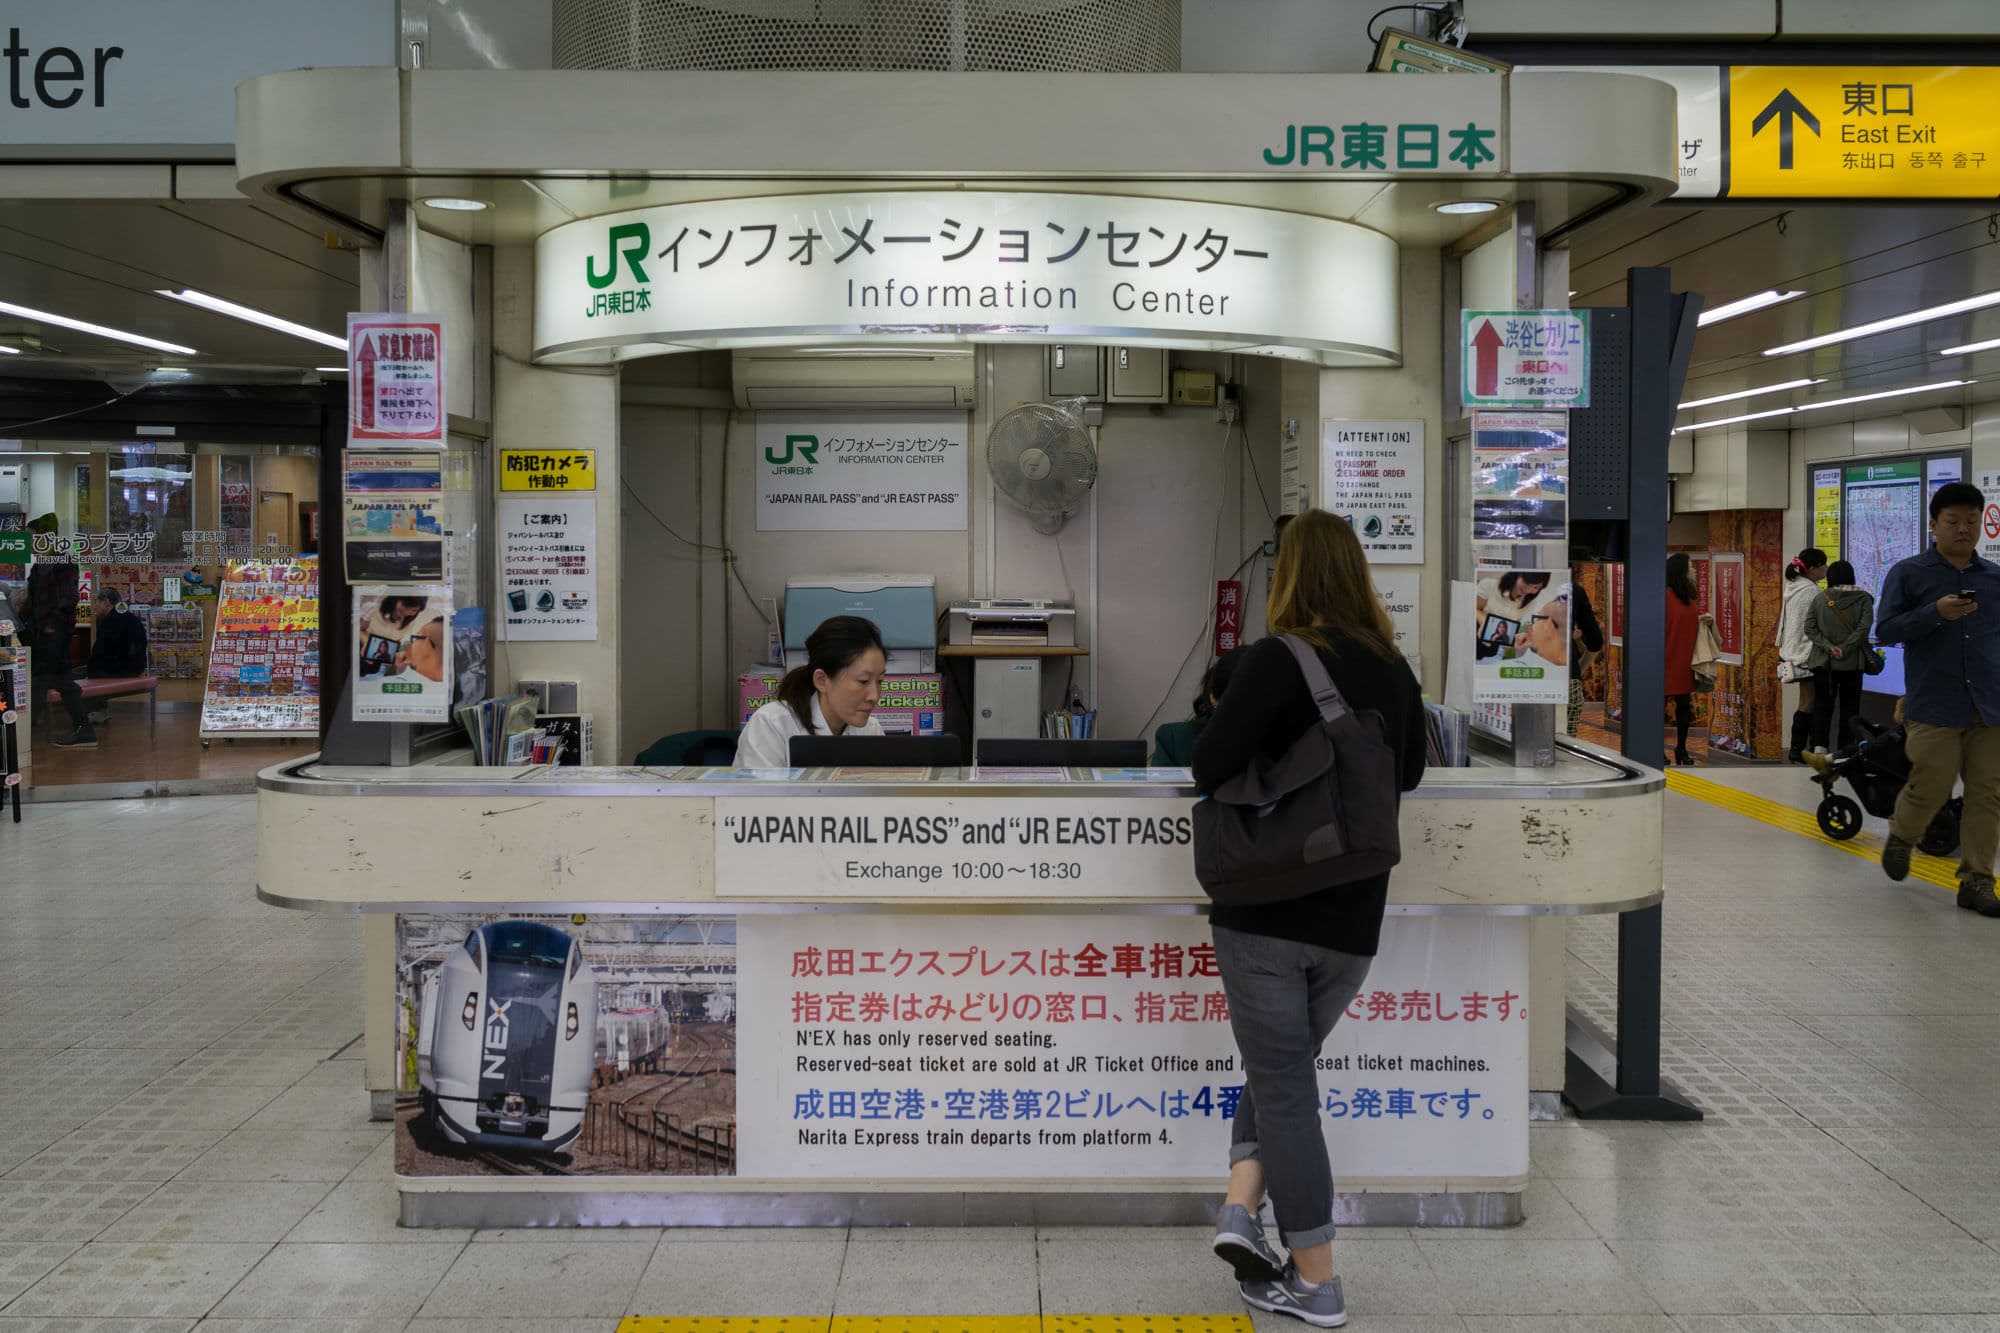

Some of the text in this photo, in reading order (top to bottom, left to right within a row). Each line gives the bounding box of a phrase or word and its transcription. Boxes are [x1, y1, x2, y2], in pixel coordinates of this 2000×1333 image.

[1841, 81, 1914, 117] 東口
[1841, 124, 1937, 144] East Exit
[1263, 122, 1496, 170] JR東日本
[1842, 152, 1895, 169] 东出口
[1908, 152, 1988, 169] 동쪽 출구
[658, 217, 1270, 273] インフォメーションセンター
[586, 222, 651, 290] JR
[586, 287, 652, 318] JR東日本
[848, 278, 1230, 316] Information Center
[1504, 320, 1580, 348] 渋谷ヒカリエ
[765, 434, 820, 465] JR
[823, 436, 960, 453] インフォメーションセンター
[506, 455, 589, 472] 防犯カメラ
[838, 455, 944, 464] INFORMATION CENTER
[771, 466, 814, 476] JR東日本
[1383, 469, 1406, 478] ORDER
[528, 474, 569, 489] 作動中
[805, 493, 828, 504] RAIL
[899, 494, 926, 504] EAST
[33, 531, 154, 554] びゅうプラザ
[35, 554, 153, 563] Travel Service Center
[1220, 588, 1238, 650] 消火器
[821, 815, 878, 845] RAIL
[962, 820, 1005, 845] and
[1056, 816, 1121, 845] EAST
[1126, 816, 1192, 845] PASS
[845, 861, 943, 881] Exchange
[791, 943, 1220, 979] 成田エクスプレスは全車指定
[843, 1031, 872, 1046] has
[878, 1031, 911, 1050] only
[918, 1031, 988, 1046] reserved
[994, 1031, 1057, 1050] seating.
[797, 1057, 915, 1073] Reserved-seat
[920, 1057, 965, 1073] ticket
[972, 1061, 998, 1073] are
[1004, 1057, 1036, 1073] sold
[1043, 1058, 1060, 1073] at
[1066, 1057, 1088, 1073] JR
[1095, 1057, 1145, 1073] Ticket
[1151, 1057, 1199, 1073] Office
[1205, 1056, 1234, 1072] and
[1358, 1055, 1402, 1071] ticket
[1410, 1054, 1490, 1072] machines.
[798, 1129, 1173, 1150] Narita Express train departs from platform 4.
